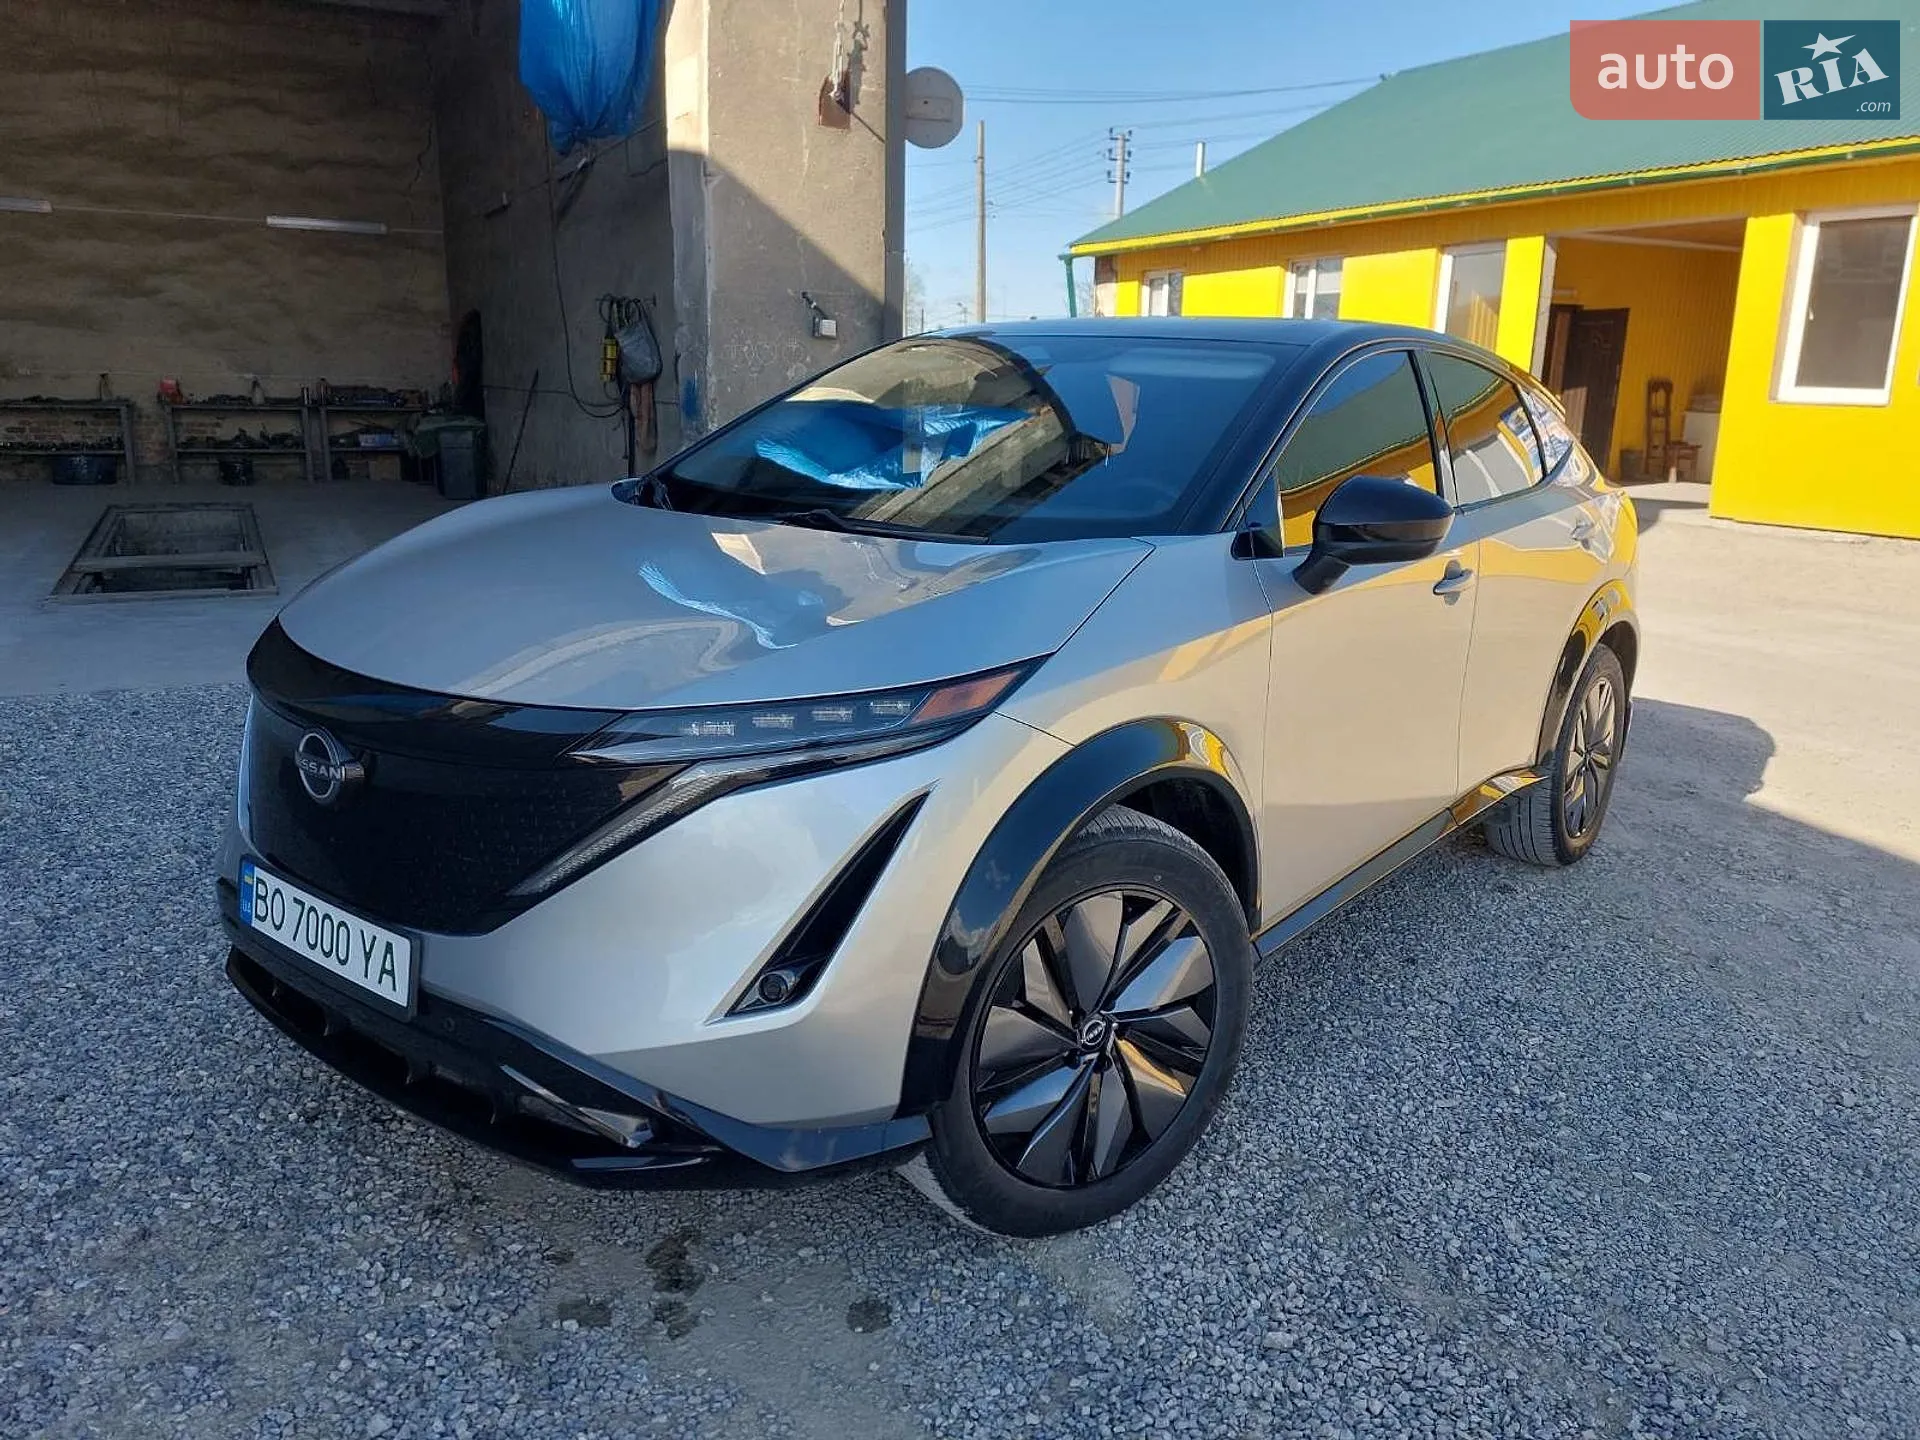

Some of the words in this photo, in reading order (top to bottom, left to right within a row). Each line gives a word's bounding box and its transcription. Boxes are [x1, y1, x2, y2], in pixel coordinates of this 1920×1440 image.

[298, 756, 341, 780] SSAN
[254, 876, 286, 931] BO
[292, 896, 351, 966] 7000
[360, 929, 397, 992] YA
